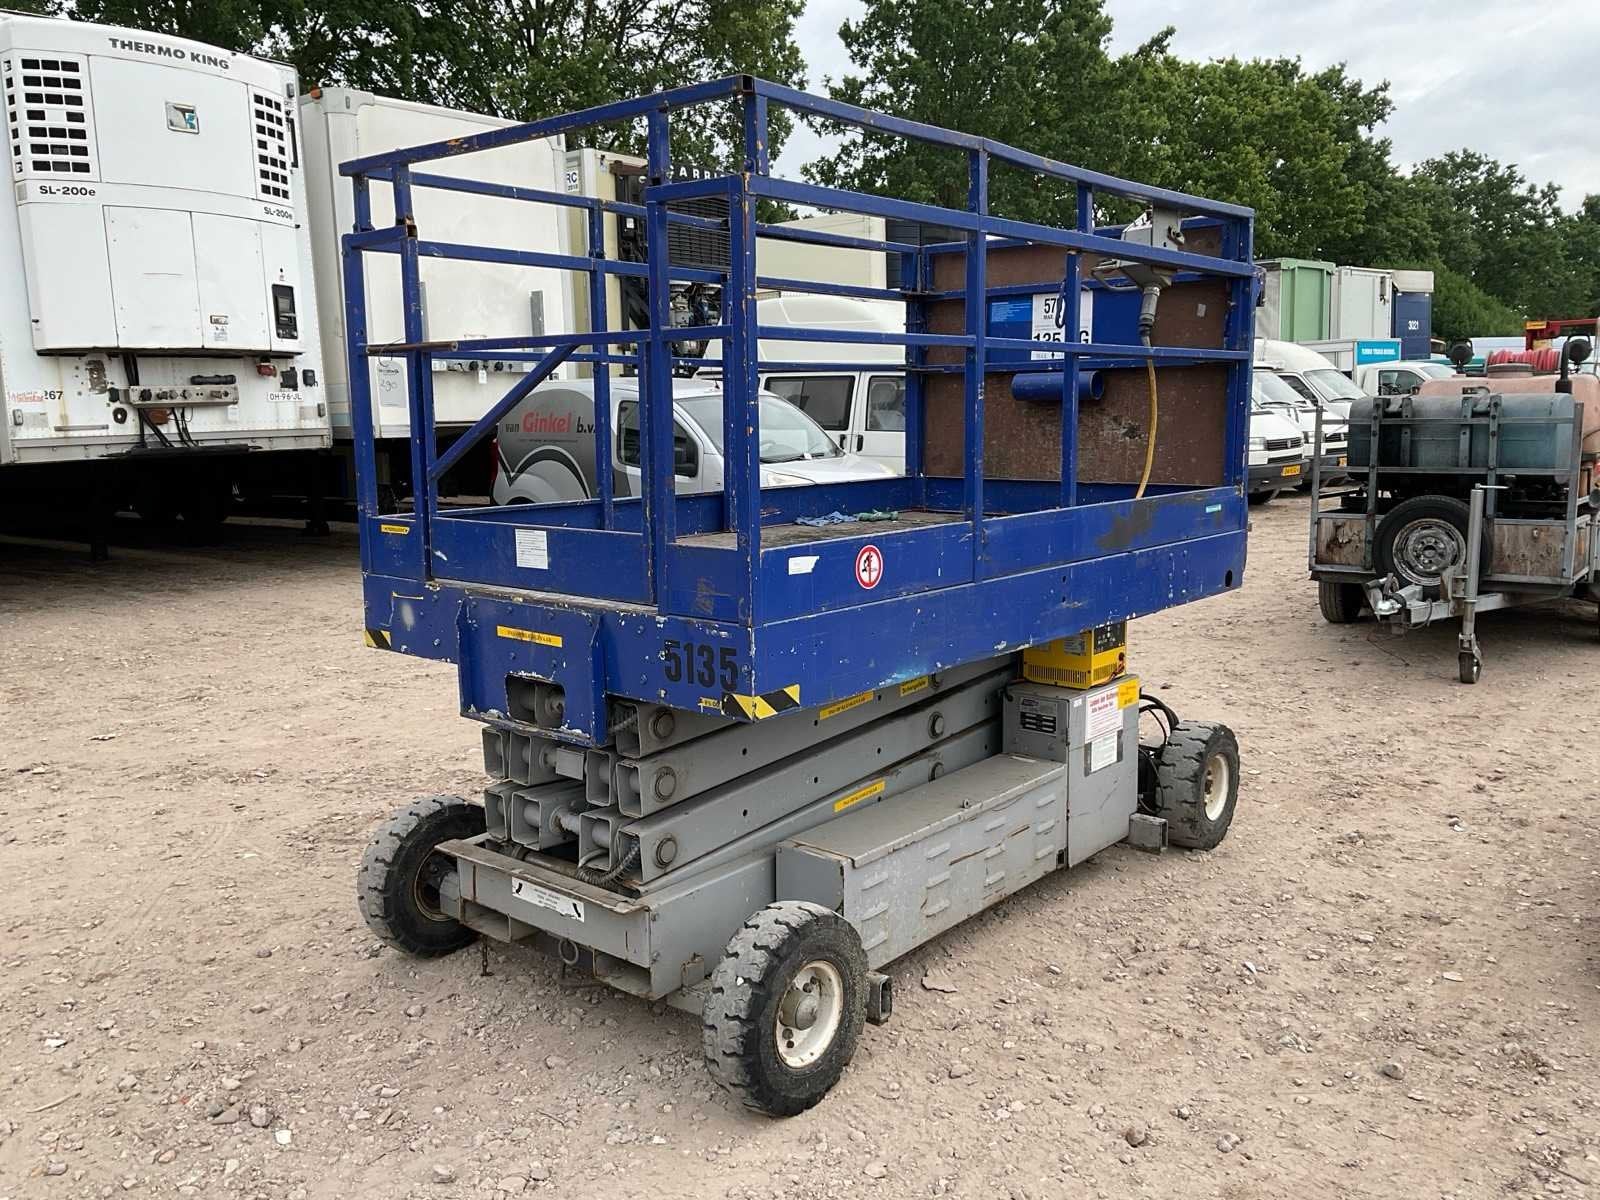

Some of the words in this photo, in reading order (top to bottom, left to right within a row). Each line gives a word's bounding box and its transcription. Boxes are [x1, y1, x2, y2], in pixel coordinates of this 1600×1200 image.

[108, 37, 186, 60] THERMO
[190, 51, 230, 70] KING
[39, 185, 96, 197] SL-200e
[505, 423, 520, 433] van
[522, 411, 573, 433] Ginkel
[664, 639, 738, 692] 5135
